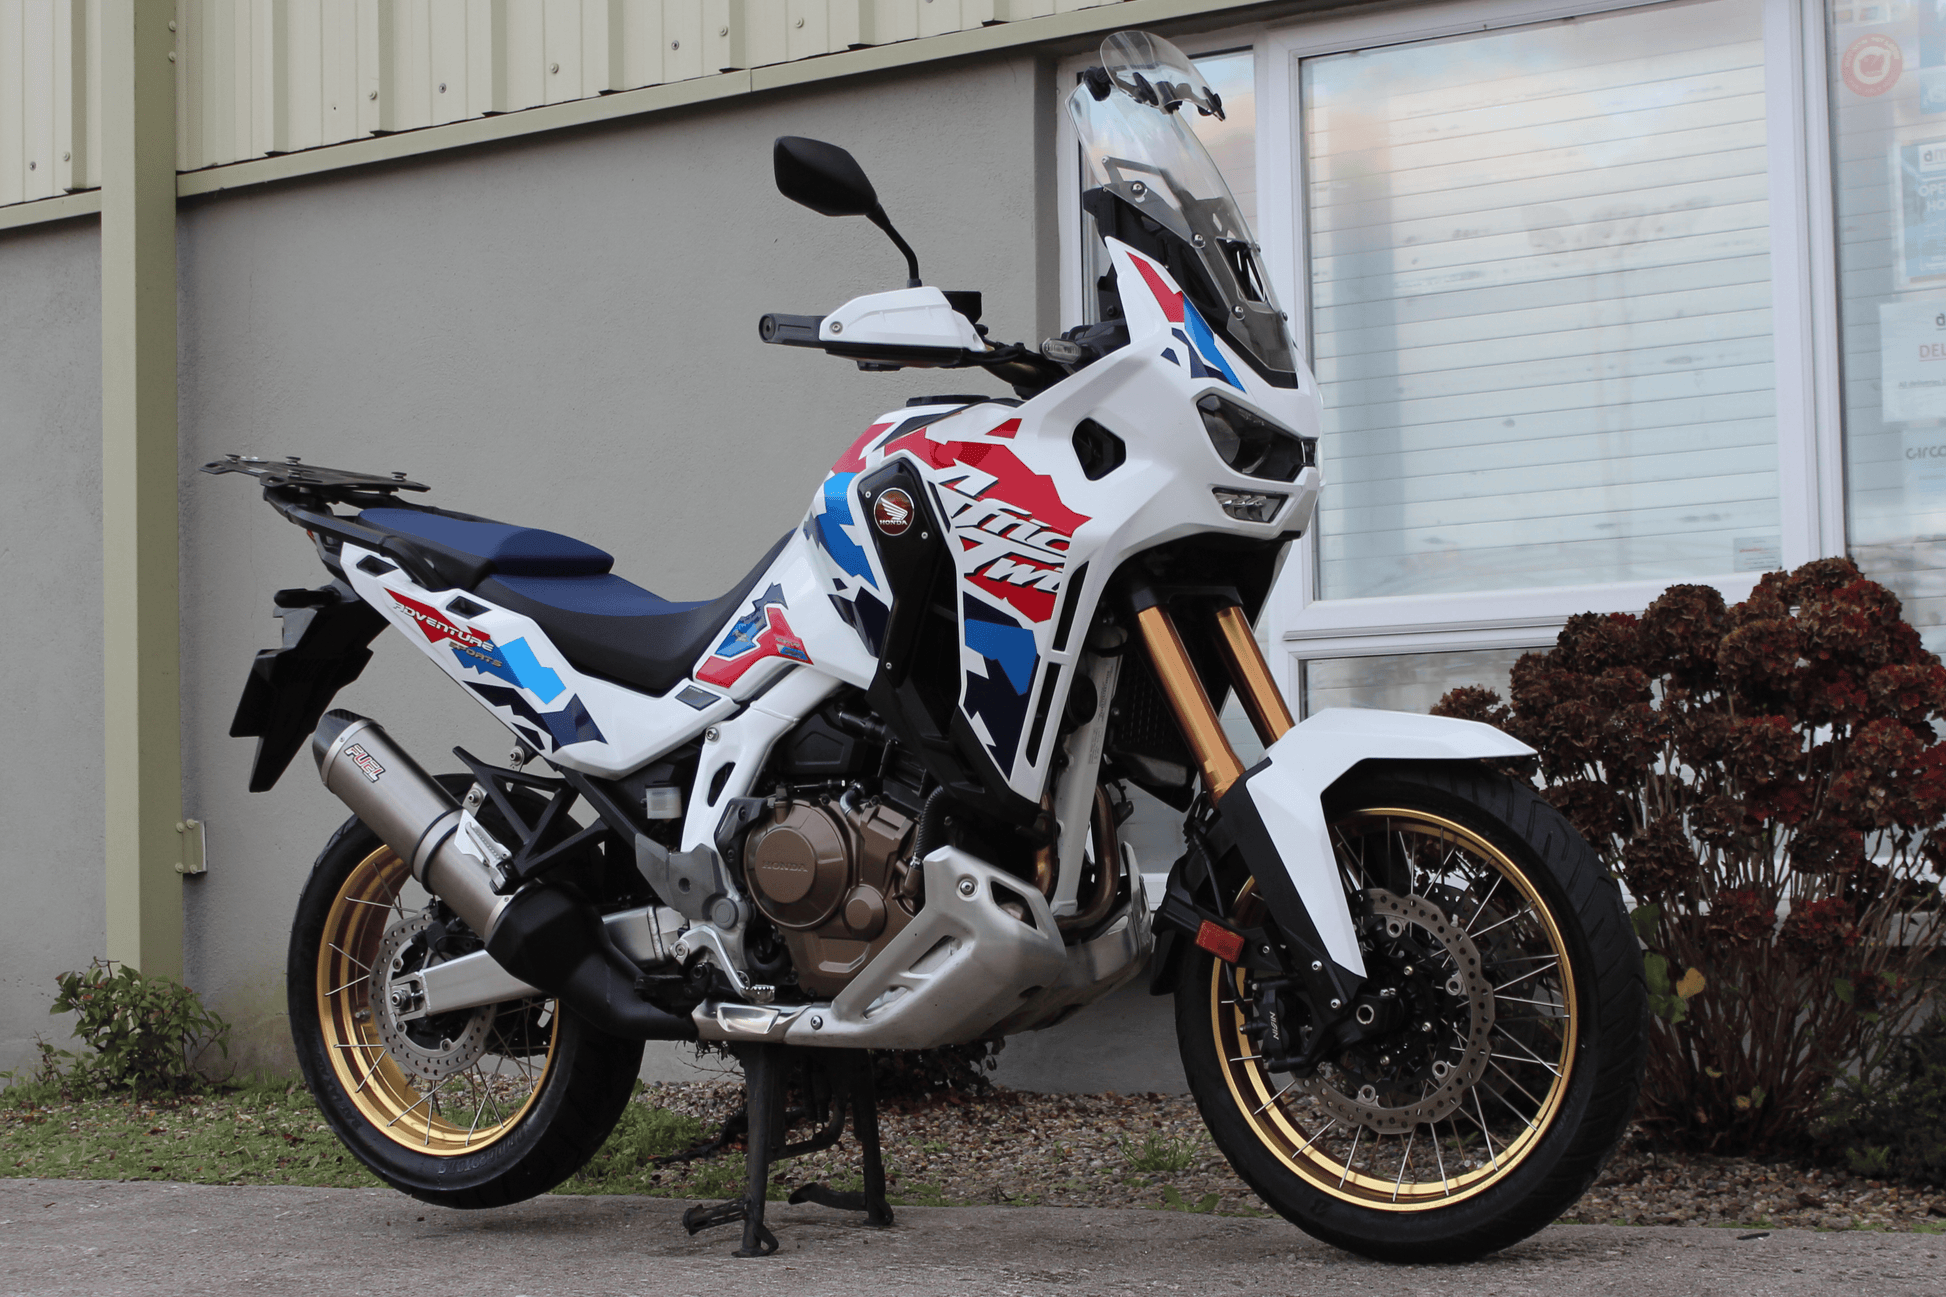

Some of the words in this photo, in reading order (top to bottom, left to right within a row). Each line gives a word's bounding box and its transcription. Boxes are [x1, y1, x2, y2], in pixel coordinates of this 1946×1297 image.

[393, 602, 494, 653] ADVENTURE
[448, 641, 504, 668] SPORTS
[344, 743, 386, 783] FUEL
[761, 860, 809, 873] HONDA
